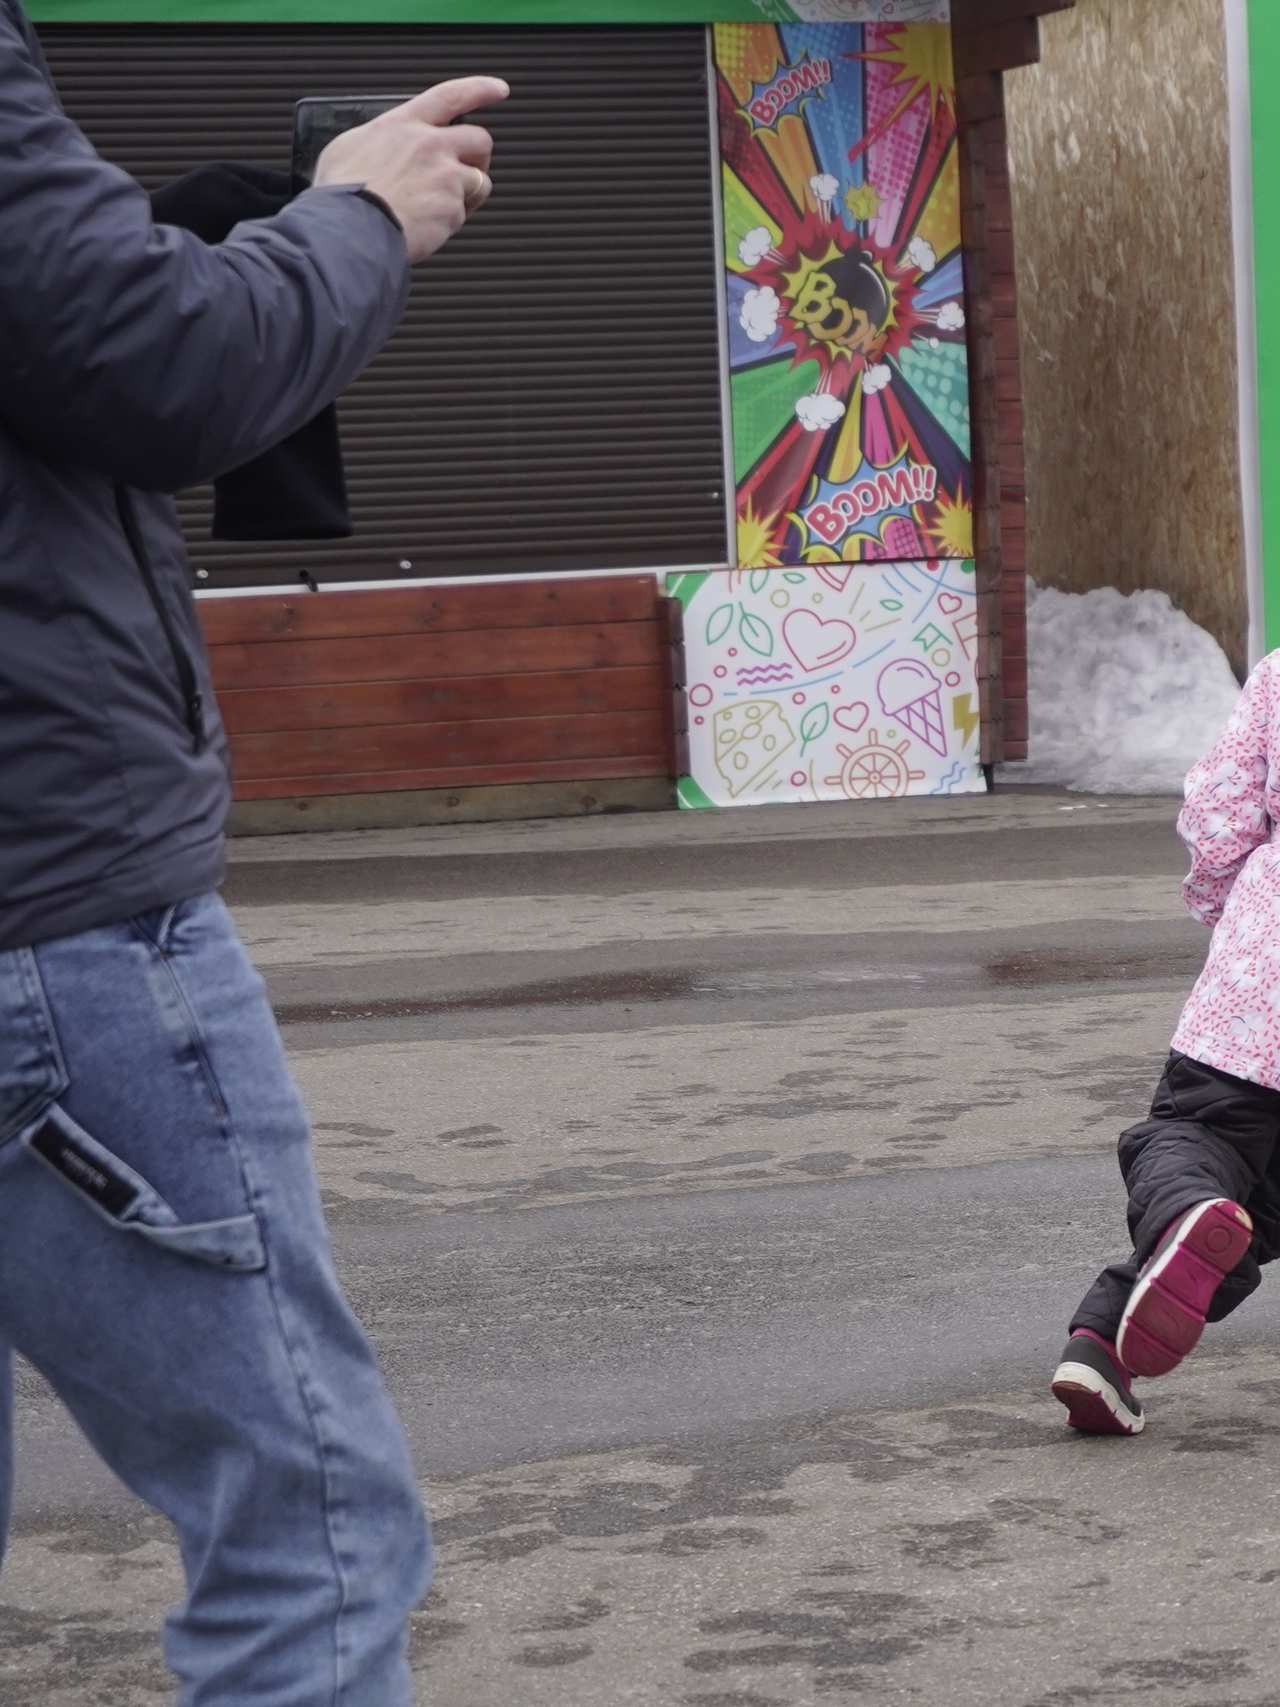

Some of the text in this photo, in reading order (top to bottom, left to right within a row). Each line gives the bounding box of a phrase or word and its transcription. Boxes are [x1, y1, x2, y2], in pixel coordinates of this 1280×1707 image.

[748, 58, 832, 127] BOOM!!
[788, 270, 889, 364] BOOM
[804, 465, 937, 545] BOOM!!
